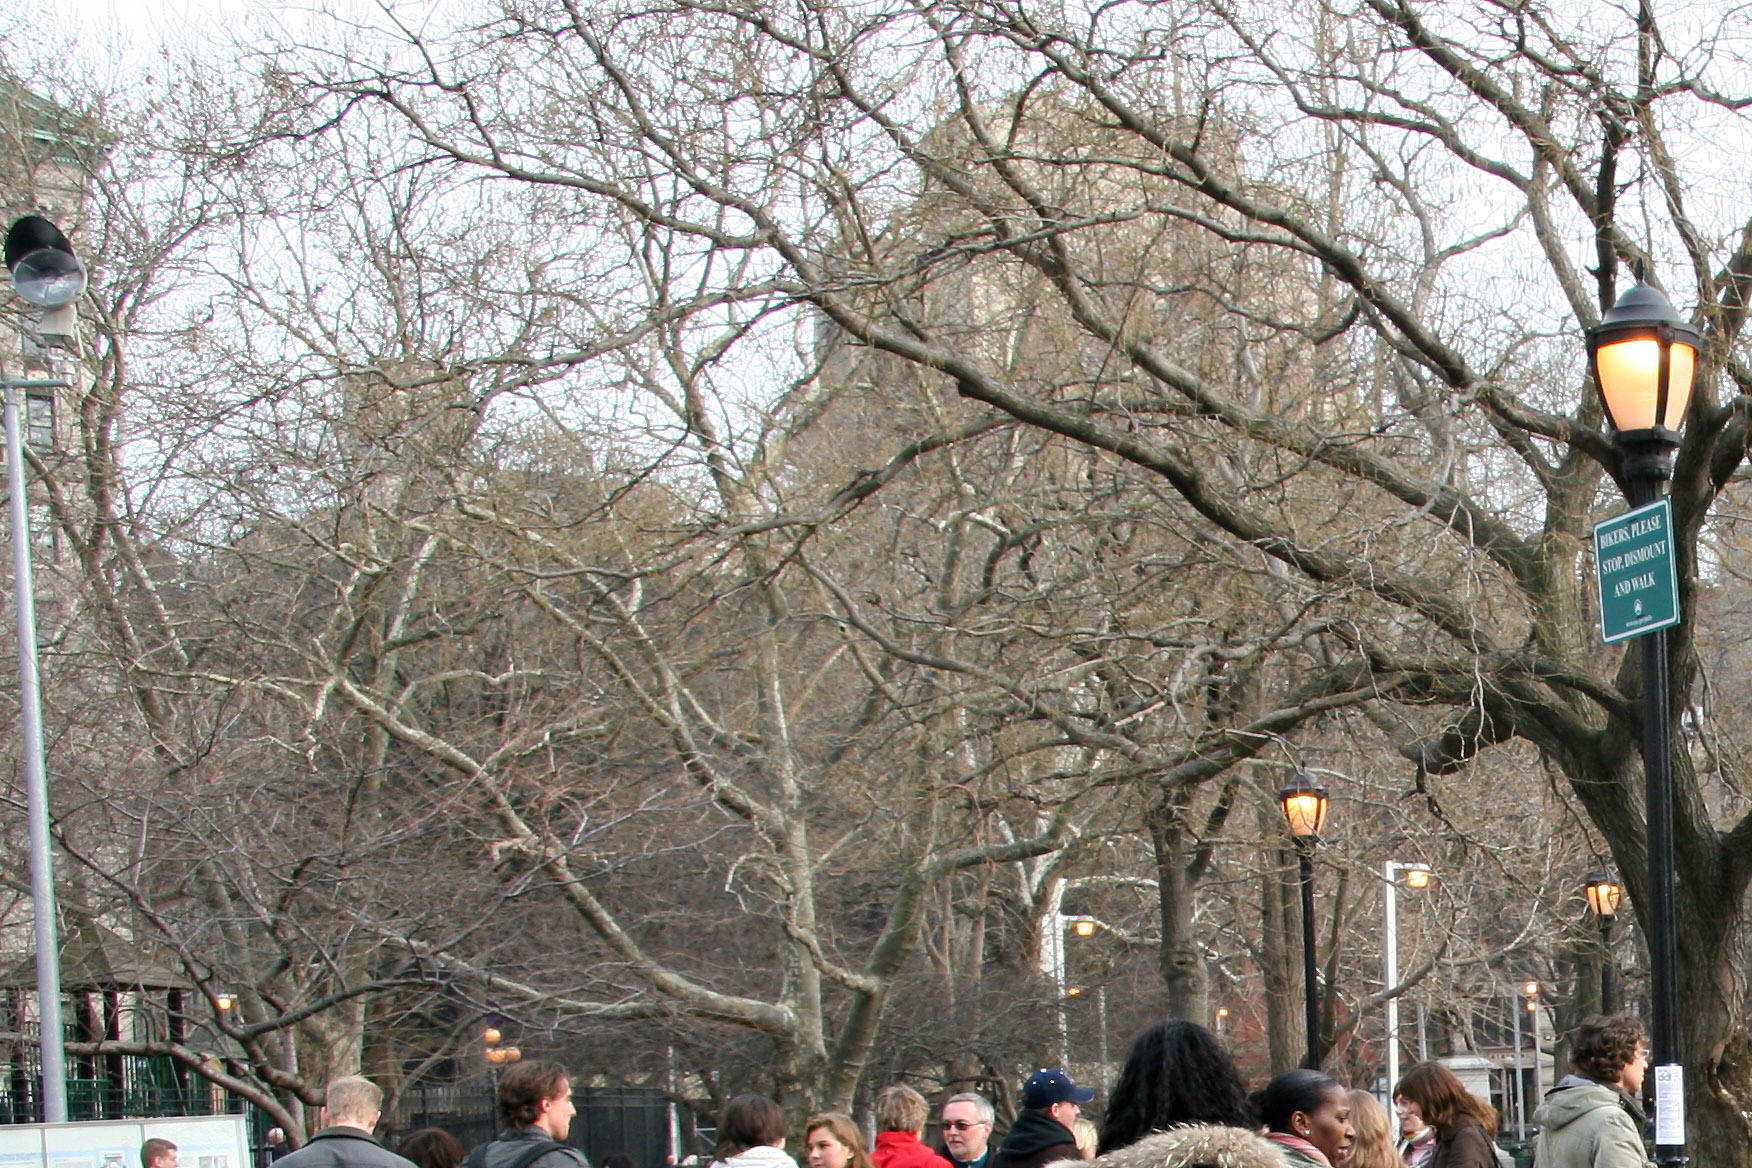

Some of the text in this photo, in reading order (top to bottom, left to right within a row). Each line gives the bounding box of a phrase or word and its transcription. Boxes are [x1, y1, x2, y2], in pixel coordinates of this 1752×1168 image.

[1631, 514, 1661, 538] PLEASE
[1625, 540, 1666, 567] DISMOUNT
[1614, 571, 1656, 597] AND WALK
